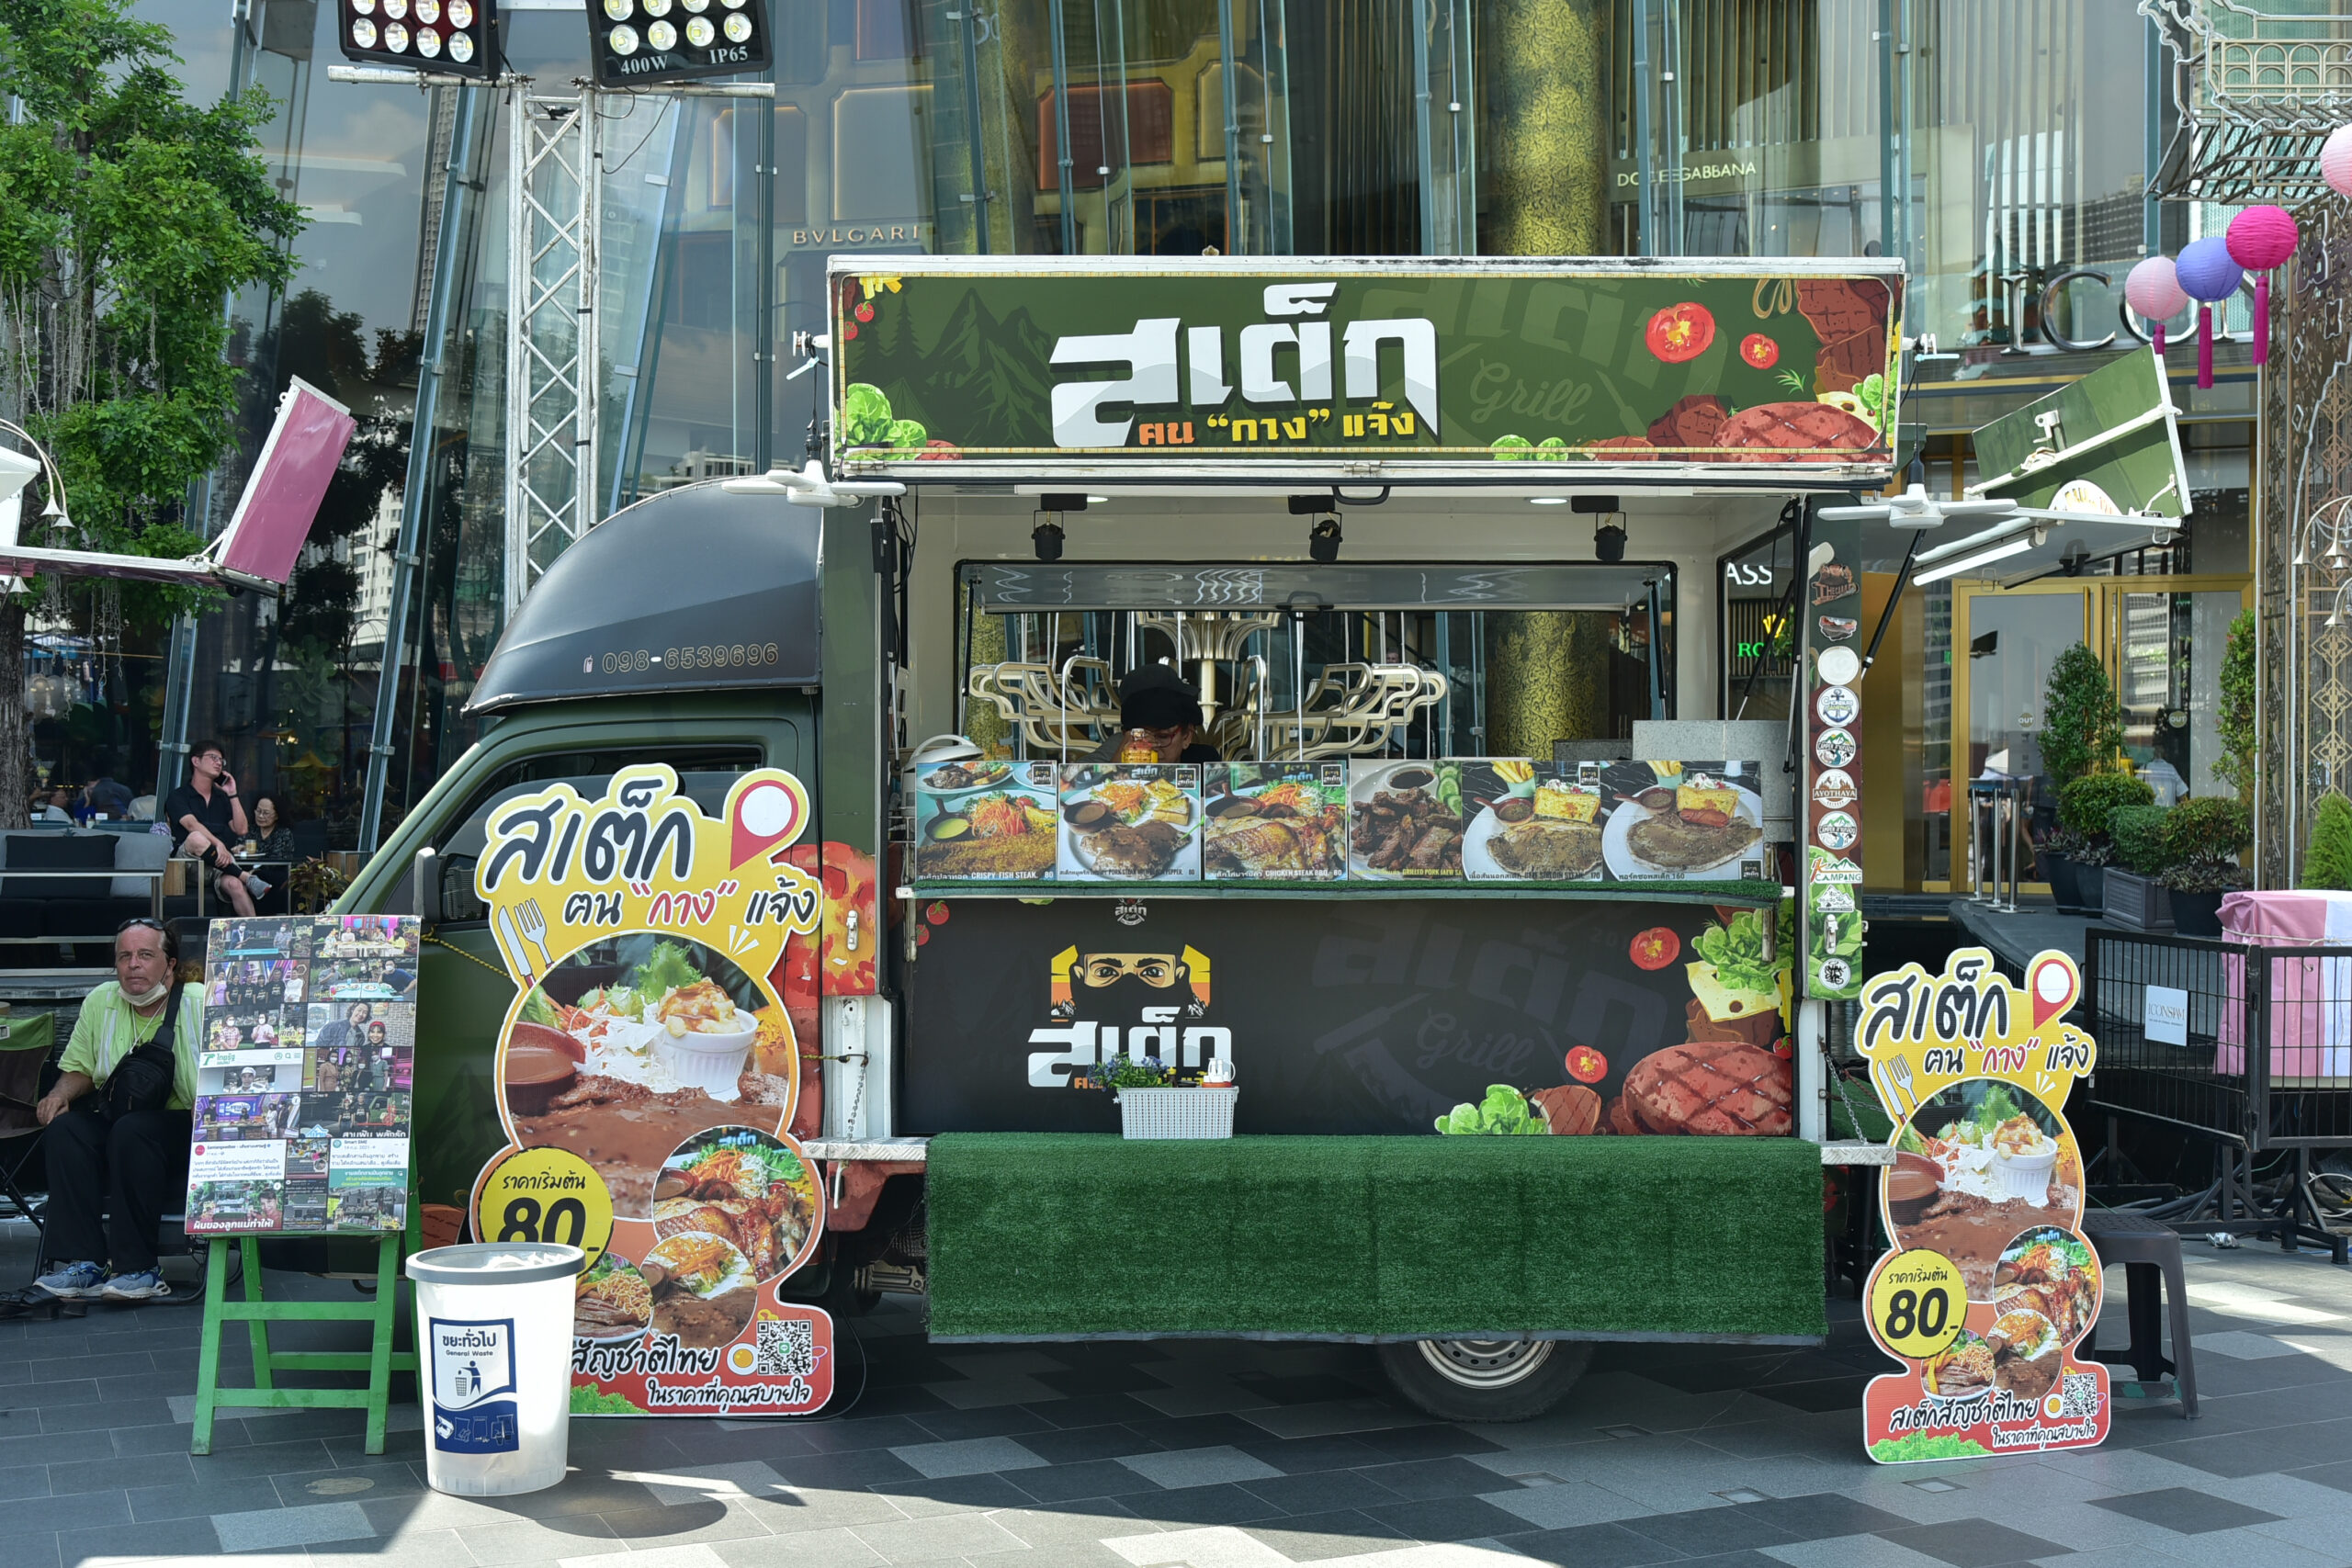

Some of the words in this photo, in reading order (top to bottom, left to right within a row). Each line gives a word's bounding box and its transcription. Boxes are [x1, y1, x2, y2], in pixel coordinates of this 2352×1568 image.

[620, 55, 669, 75] 400W
[709, 46, 749, 64] IP65
[793, 225, 919, 244] BVLGARI
[1470, 357, 1593, 426] Grill
[1342, 401, 1415, 438] แจ้ง
[602, 642, 779, 674] 098-6539696
[2169, 715, 2187, 723] OUT
[486, 778, 689, 889] สเต็ก
[971, 871, 995, 879] CRISPY
[999, 871, 1013, 879] FISH
[746, 875, 816, 925] แจ้ง
[1865, 959, 2007, 1047] สเต็ก
[1417, 1008, 1536, 1078] Grill
[2047, 1033, 2089, 1070] แจ้ง
[503, 1167, 586, 1190] ราคาเริ่มต้น
[497, 1196, 600, 1252] 80-
[1889, 1264, 1948, 1284] ราคาเริ่มต้น
[1885, 1288, 1959, 1339] 80.-
[442, 1328, 497, 1348] ขยะทั่วไป
[446, 1349, 470, 1358] General
[472, 1349, 493, 1358] Waste
[571, 1336, 718, 1380] สัญชาติไทย
[648, 1376, 811, 1413] ในราคาที่คุณสบายใจ
[1890, 1392, 2039, 1430] สเต็กสัญชาติไทย
[1993, 1418, 2098, 1450] ในราคาที่คุณสบายใจ
